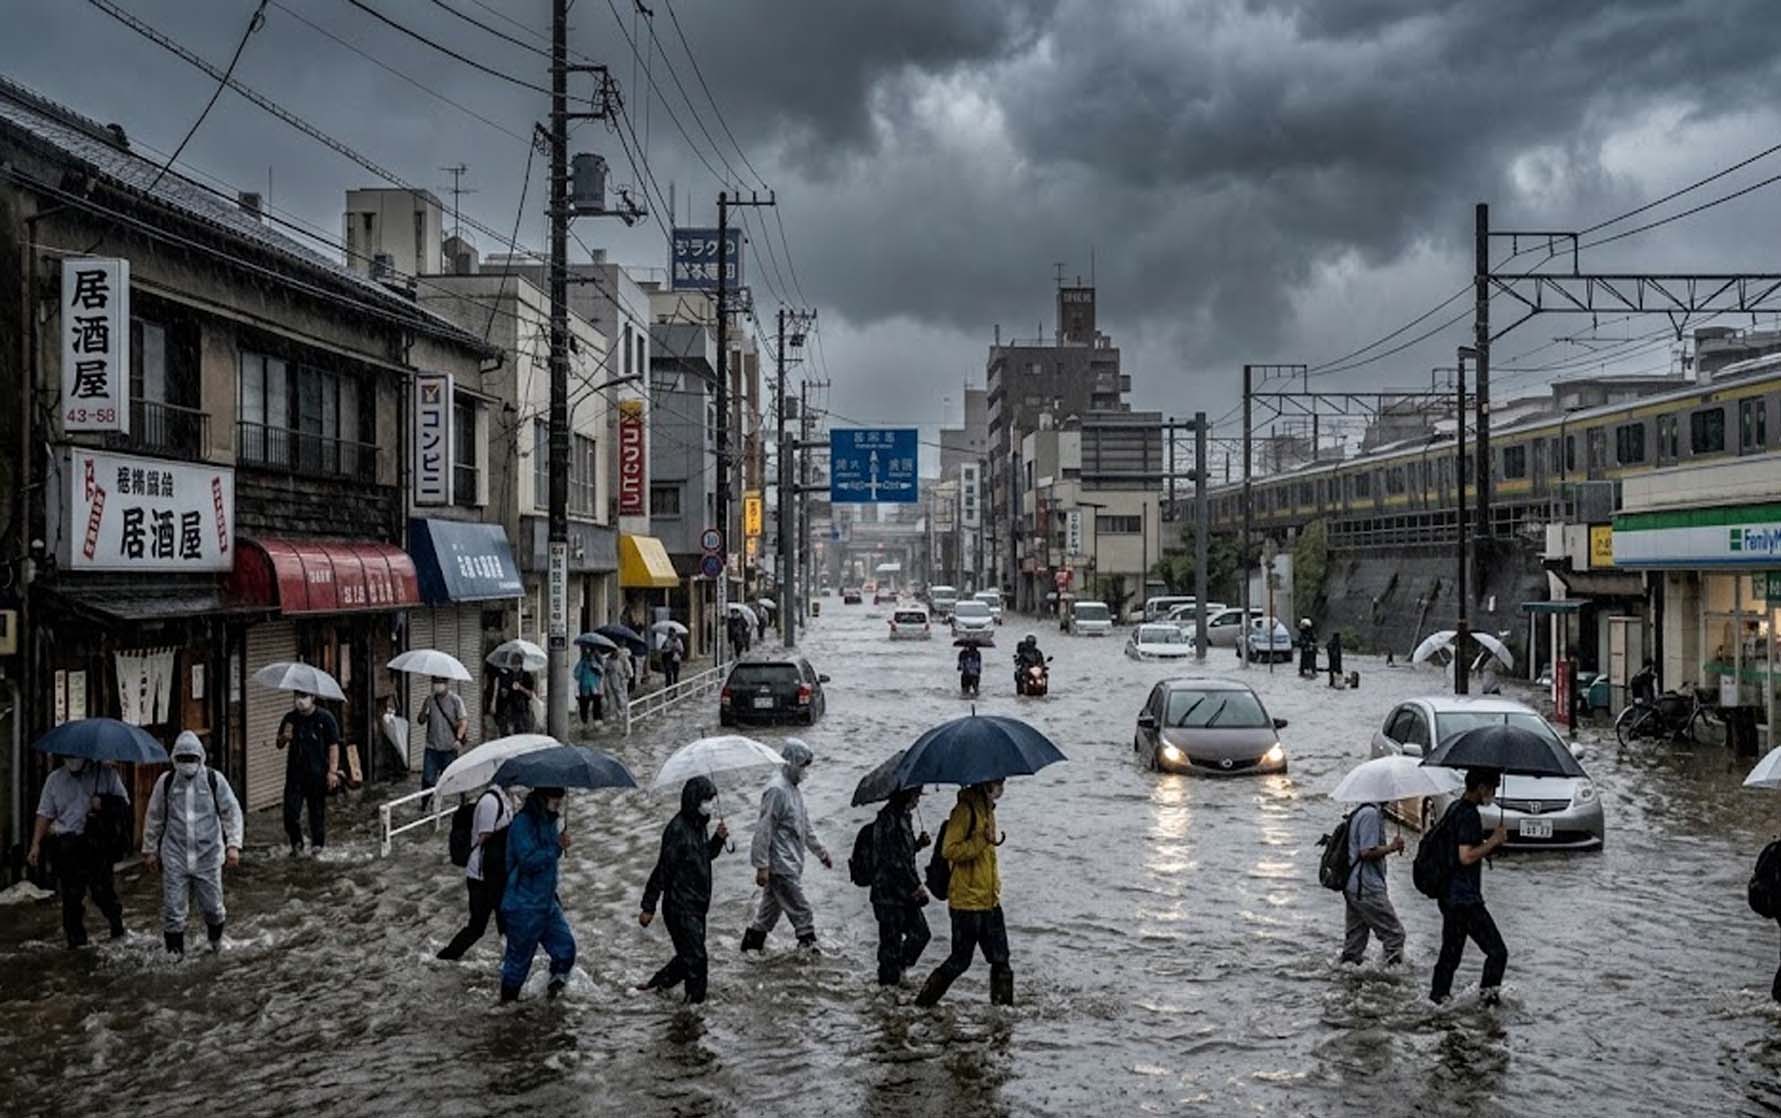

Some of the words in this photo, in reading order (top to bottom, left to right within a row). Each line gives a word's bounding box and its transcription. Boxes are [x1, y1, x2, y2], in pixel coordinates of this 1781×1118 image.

[71, 269, 110, 399] 居酒屋
[120, 507, 203, 560] 居酒屋
